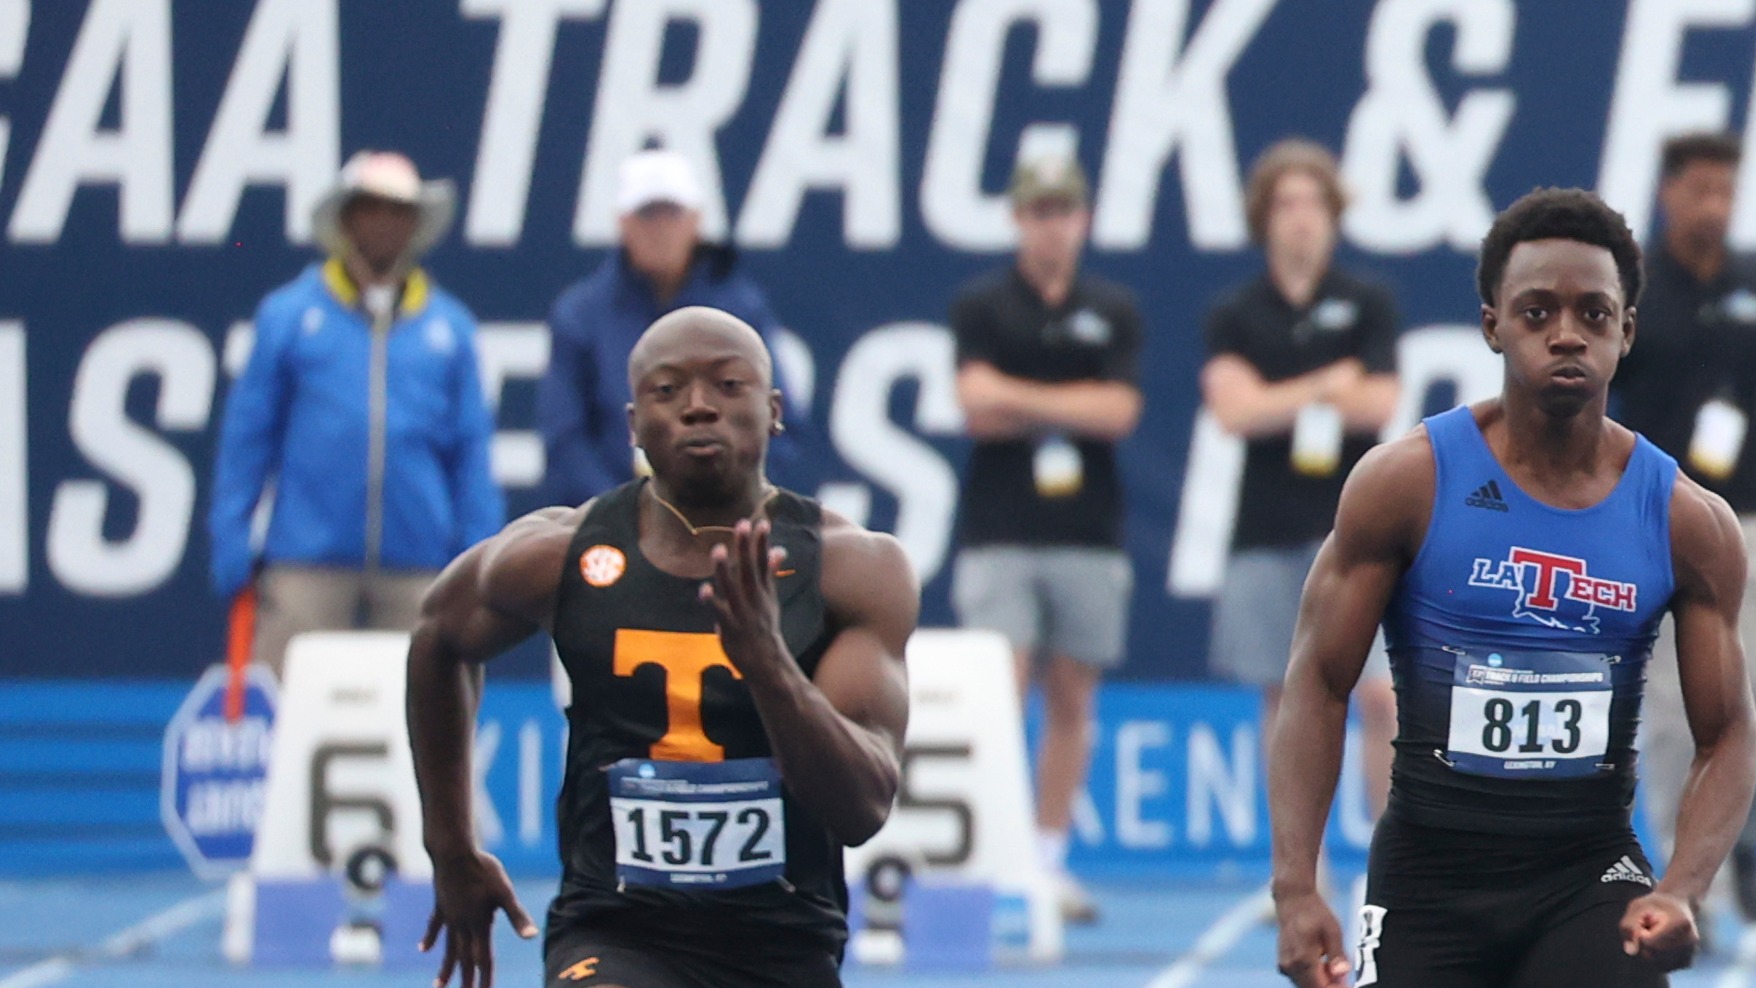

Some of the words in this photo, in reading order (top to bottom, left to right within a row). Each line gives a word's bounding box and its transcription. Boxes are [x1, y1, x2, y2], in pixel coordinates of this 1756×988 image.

[459, 0, 1280, 252] TRACK
[613, 628, 743, 763] T
[1482, 697, 1582, 754] 813
[627, 808, 773, 867] 1572
[900, 742, 973, 868] 5
[1600, 871, 1652, 888] adidas
